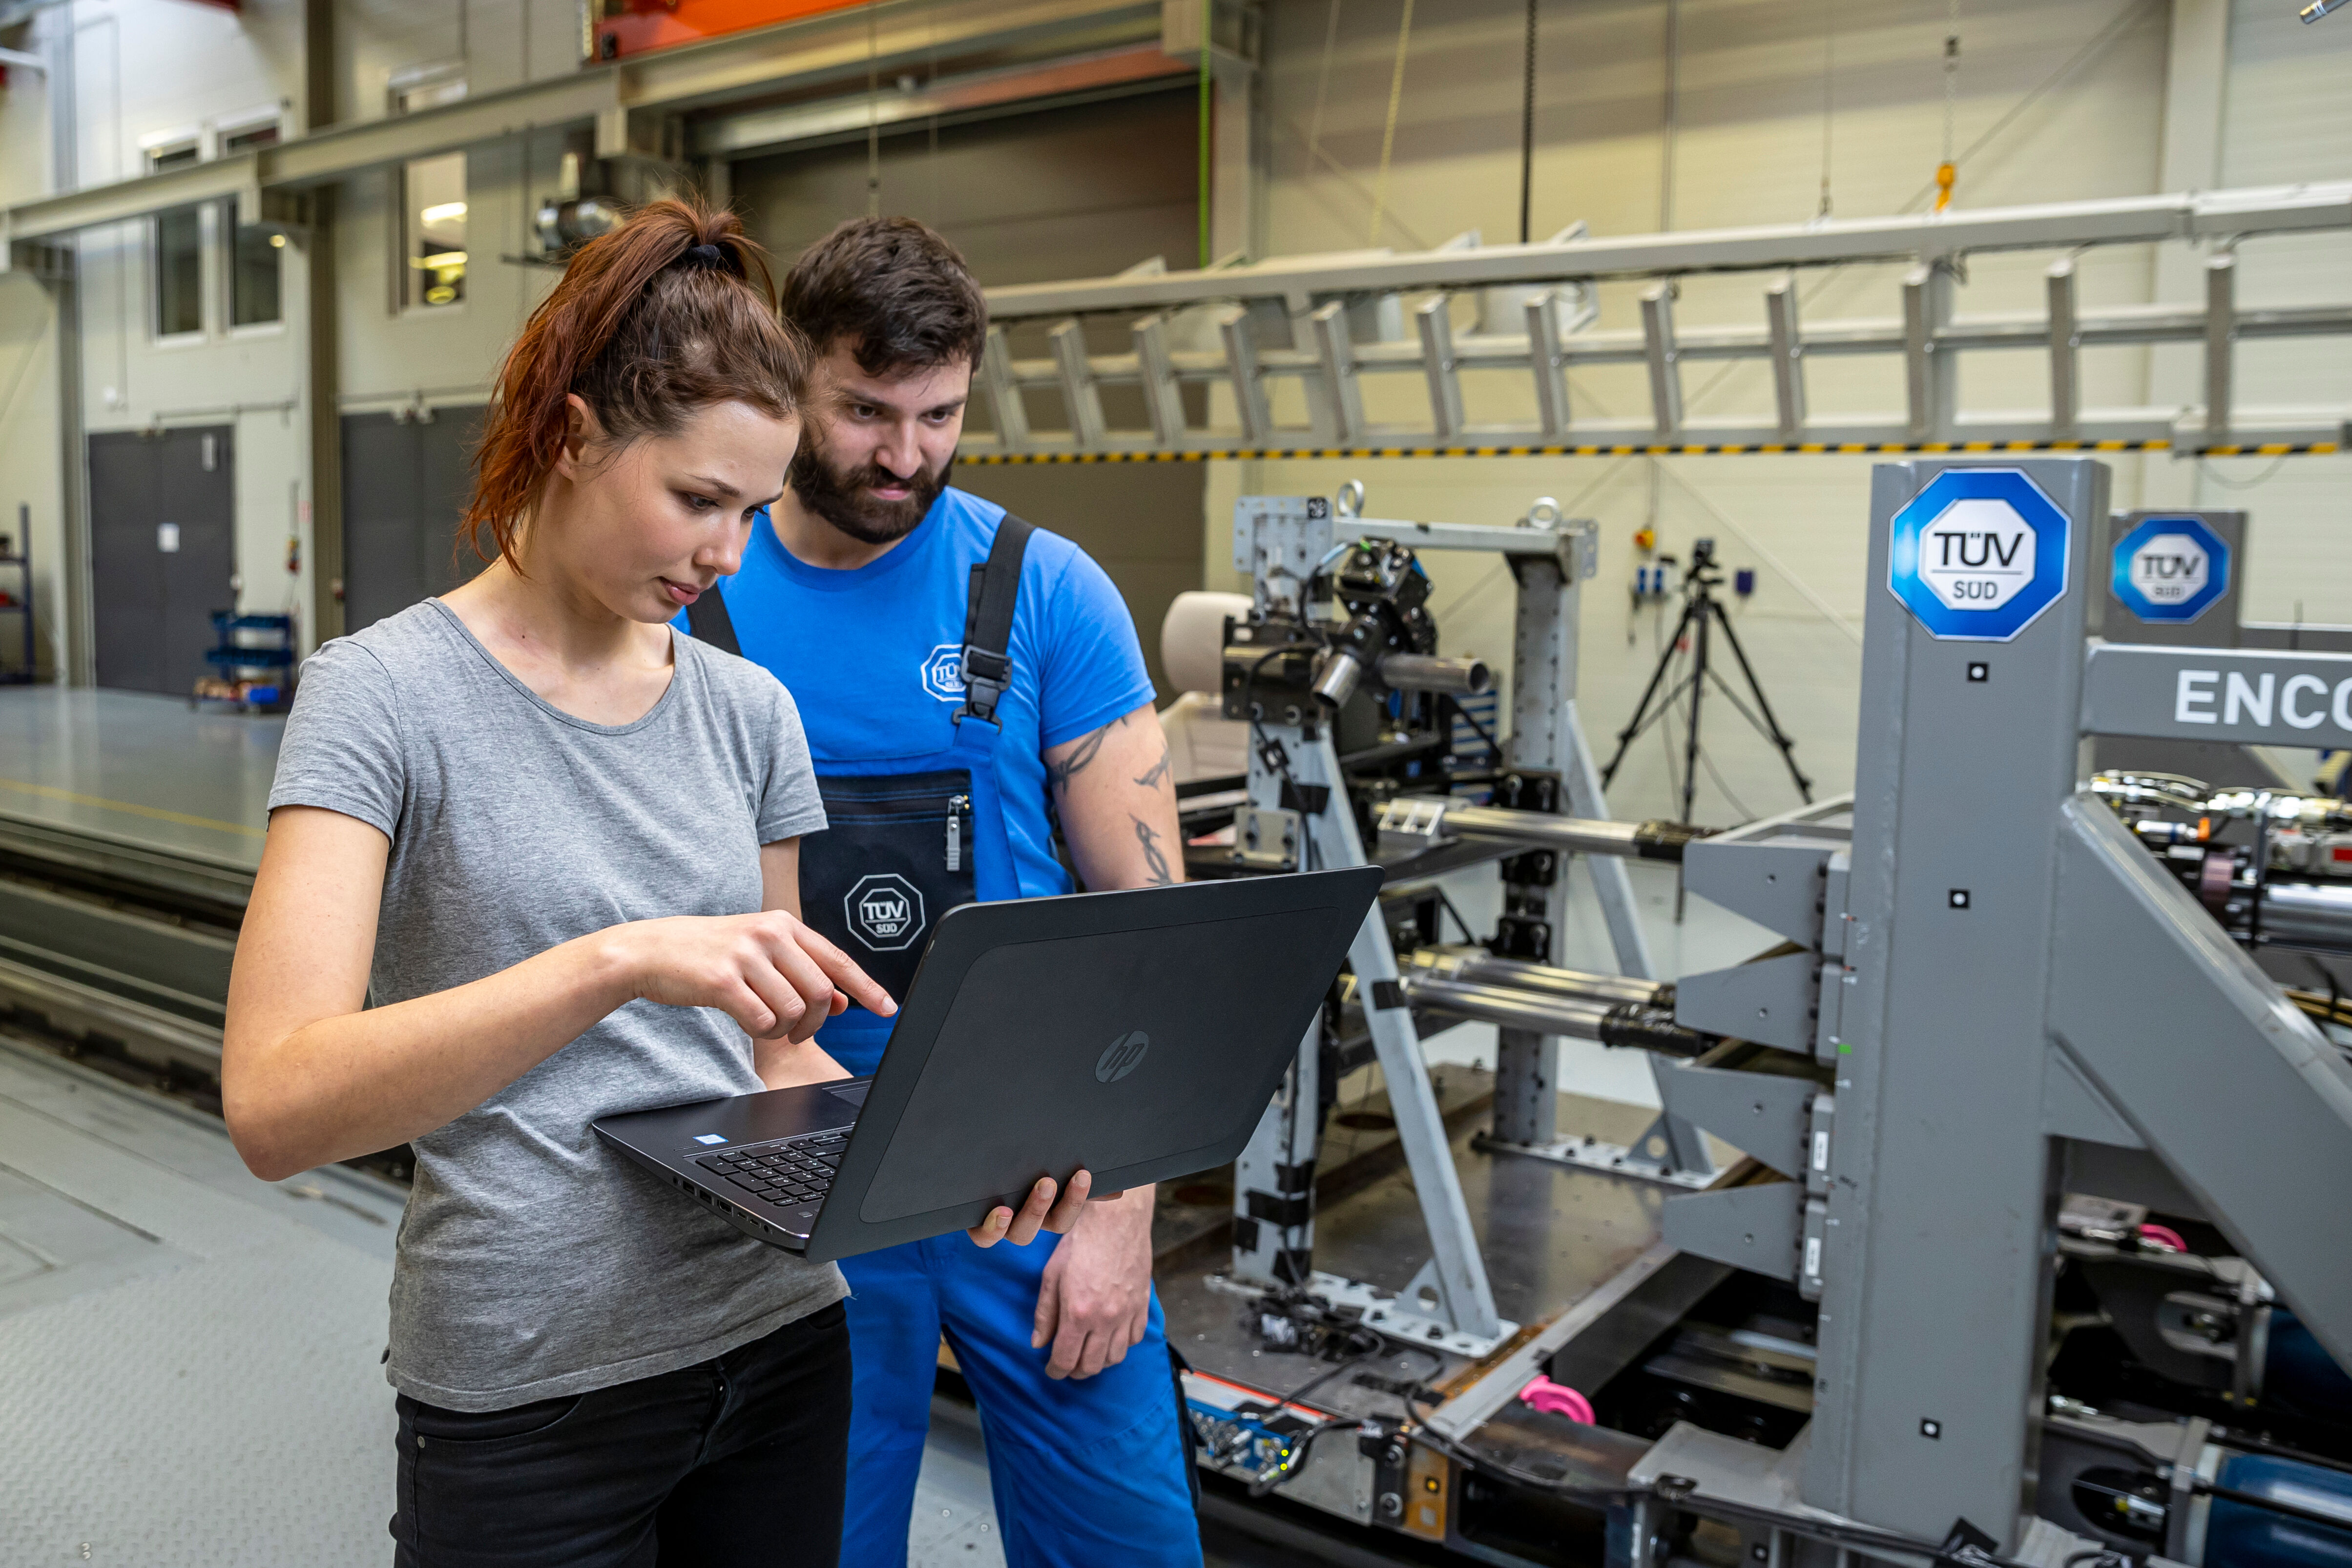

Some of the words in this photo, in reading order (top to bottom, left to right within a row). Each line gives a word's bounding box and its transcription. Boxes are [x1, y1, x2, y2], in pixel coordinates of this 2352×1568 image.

[1934, 532, 2023, 566] TÜV
[1954, 580, 1998, 600] SÜD
[863, 900, 904, 920] TÜV
[875, 922, 897, 934] SÜD
[1100, 1031, 1145, 1083] hp
